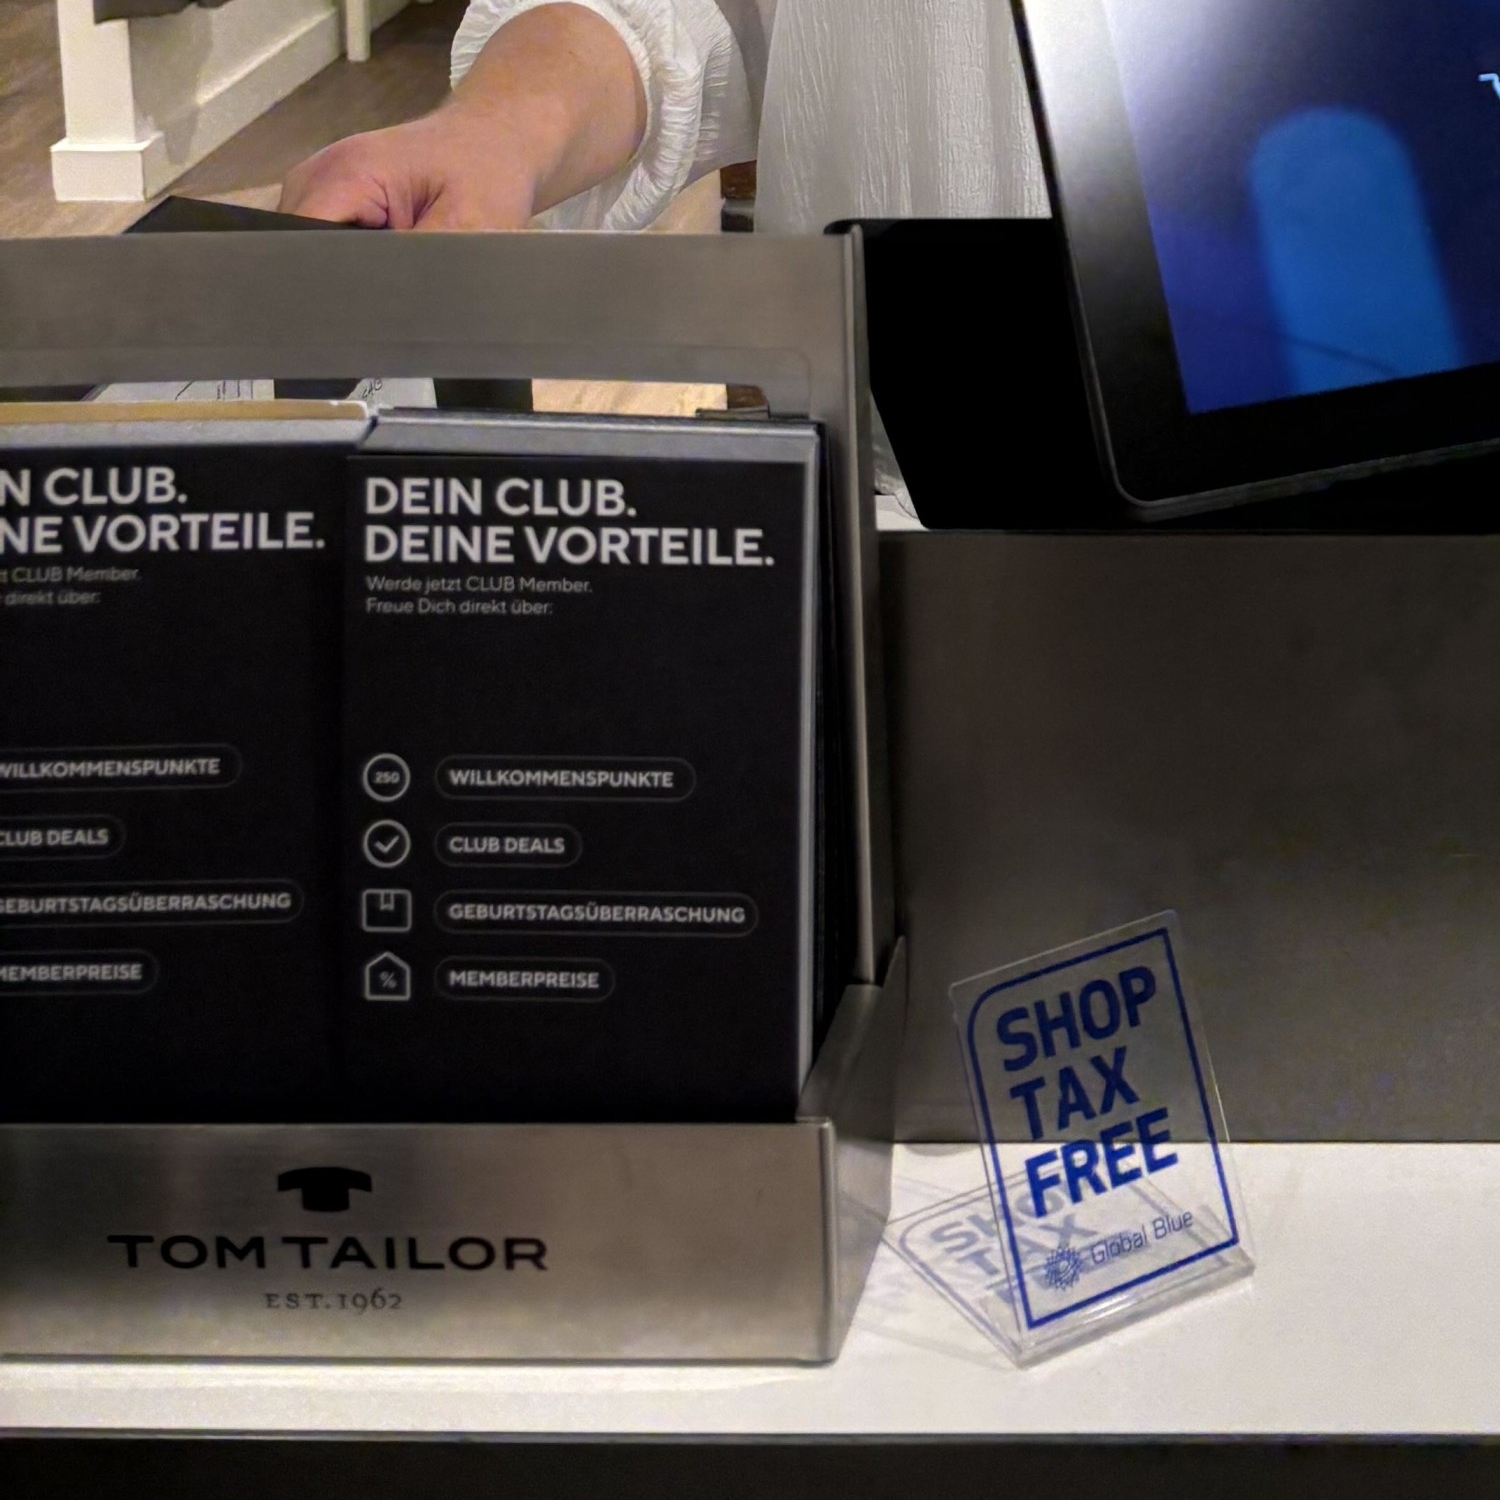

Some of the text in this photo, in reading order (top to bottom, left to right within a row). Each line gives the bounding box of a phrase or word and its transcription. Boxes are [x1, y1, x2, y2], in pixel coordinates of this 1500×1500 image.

[43, 466, 188, 506] CLUB.
[365, 476, 637, 517] DEIN CLUB.
[72, 511, 326, 552] VORTEILE.
[364, 524, 775, 567] DEINE VORTEILE.
[11, 566, 63, 583] CLUB
[366, 576, 593, 595] Werde jetzt CLUB Member.
[366, 598, 414, 614] Freue
[417, 598, 456, 614] Dich
[459, 598, 508, 614] direkt
[374, 770, 400, 784] 250
[448, 768, 675, 789] WILLKOMMENSPUNKTE
[46, 828, 110, 846] DEALS
[448, 836, 566, 855] CLUB DEALS
[448, 902, 746, 924] GEBURTSTAGSÜBERRASCHUNG
[448, 970, 600, 989] MEMBERPREISE
[995, 964, 1157, 1073] SHOP
[1008, 1044, 1141, 1142] TAX
[1022, 1105, 1180, 1219] FREE
[1090, 1208, 1194, 1265] Global Blue
[106, 1234, 549, 1271] TOM TAILOR
[264, 1290, 402, 1314] EST.1962
